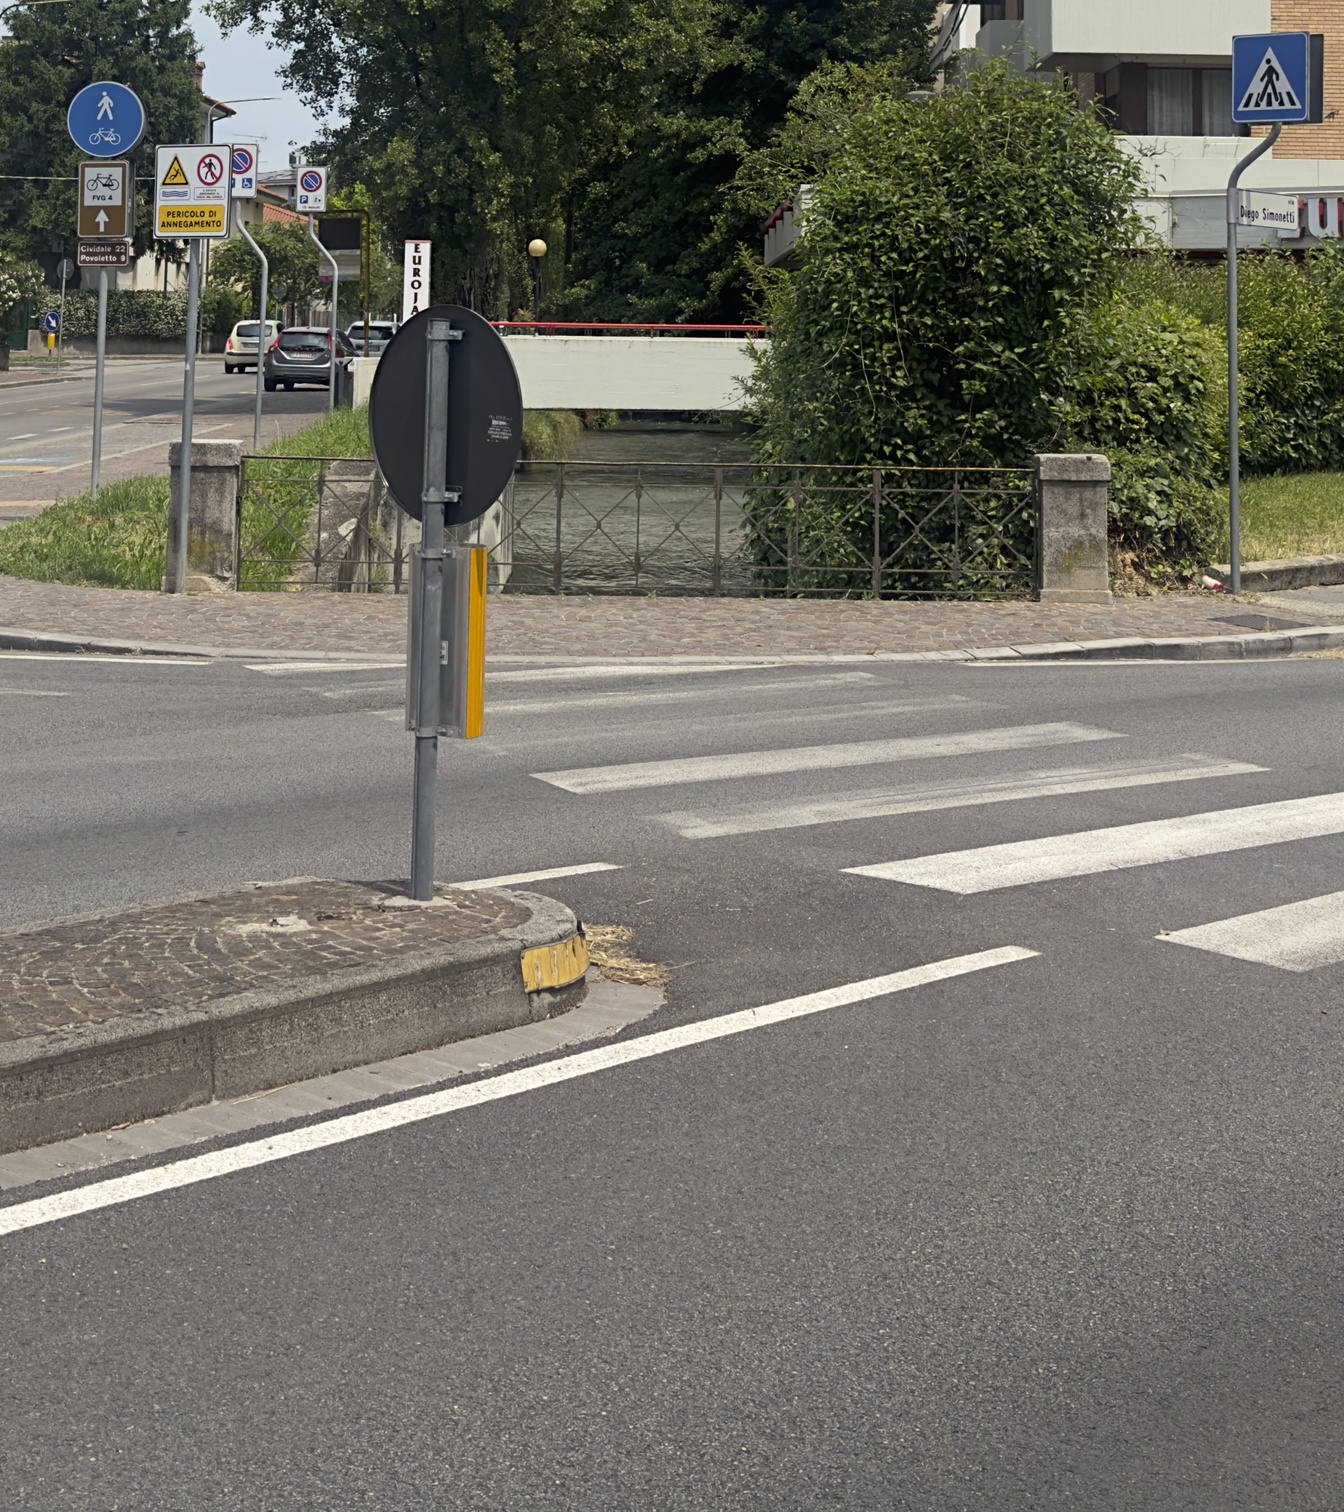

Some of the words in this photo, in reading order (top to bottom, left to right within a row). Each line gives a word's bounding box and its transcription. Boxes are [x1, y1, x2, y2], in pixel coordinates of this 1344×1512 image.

[166, 210, 205, 218] PERICOLO
[208, 210, 217, 218] DI
[1240, 205, 1259, 222] Diego
[1262, 207, 1295, 224] Simonetti
[161, 220, 222, 228] ANNEGAMENTO
[80, 245, 112, 253] Cividale
[115, 245, 126, 253] 22
[80, 254, 117, 262] Povoletto
[120, 254, 126, 262] 9
